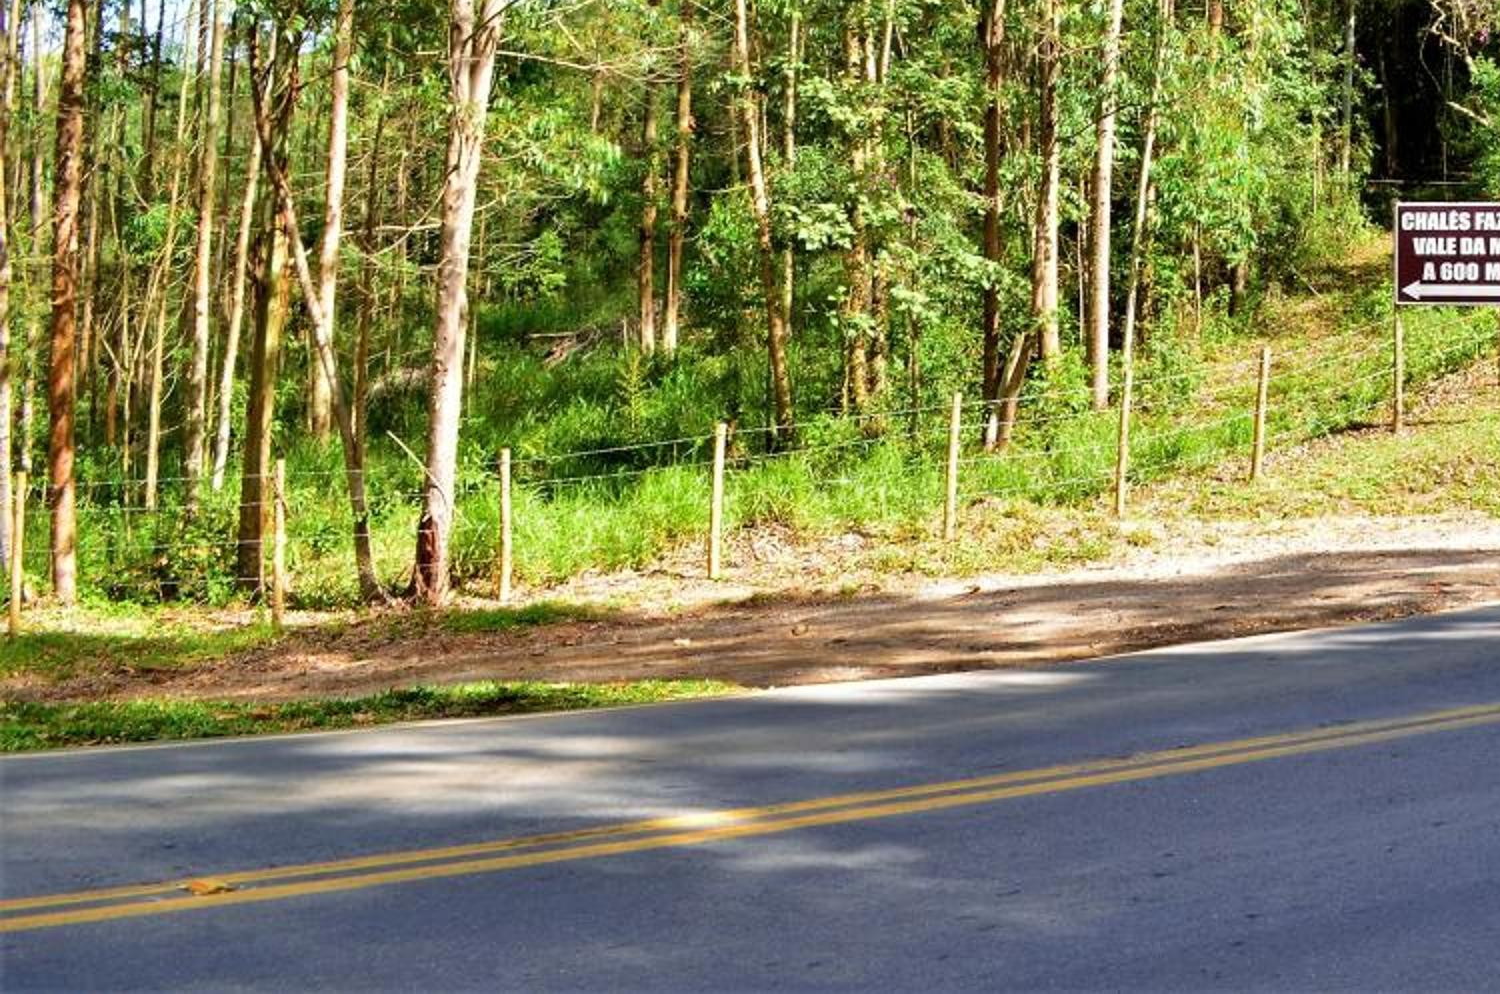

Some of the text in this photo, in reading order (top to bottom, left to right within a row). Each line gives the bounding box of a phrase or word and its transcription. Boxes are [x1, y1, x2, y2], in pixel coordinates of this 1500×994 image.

[1412, 237, 1457, 255] VALE
[1460, 237, 1486, 255] DA
[1422, 262, 1436, 281] A
[1440, 262, 1479, 281] 600
